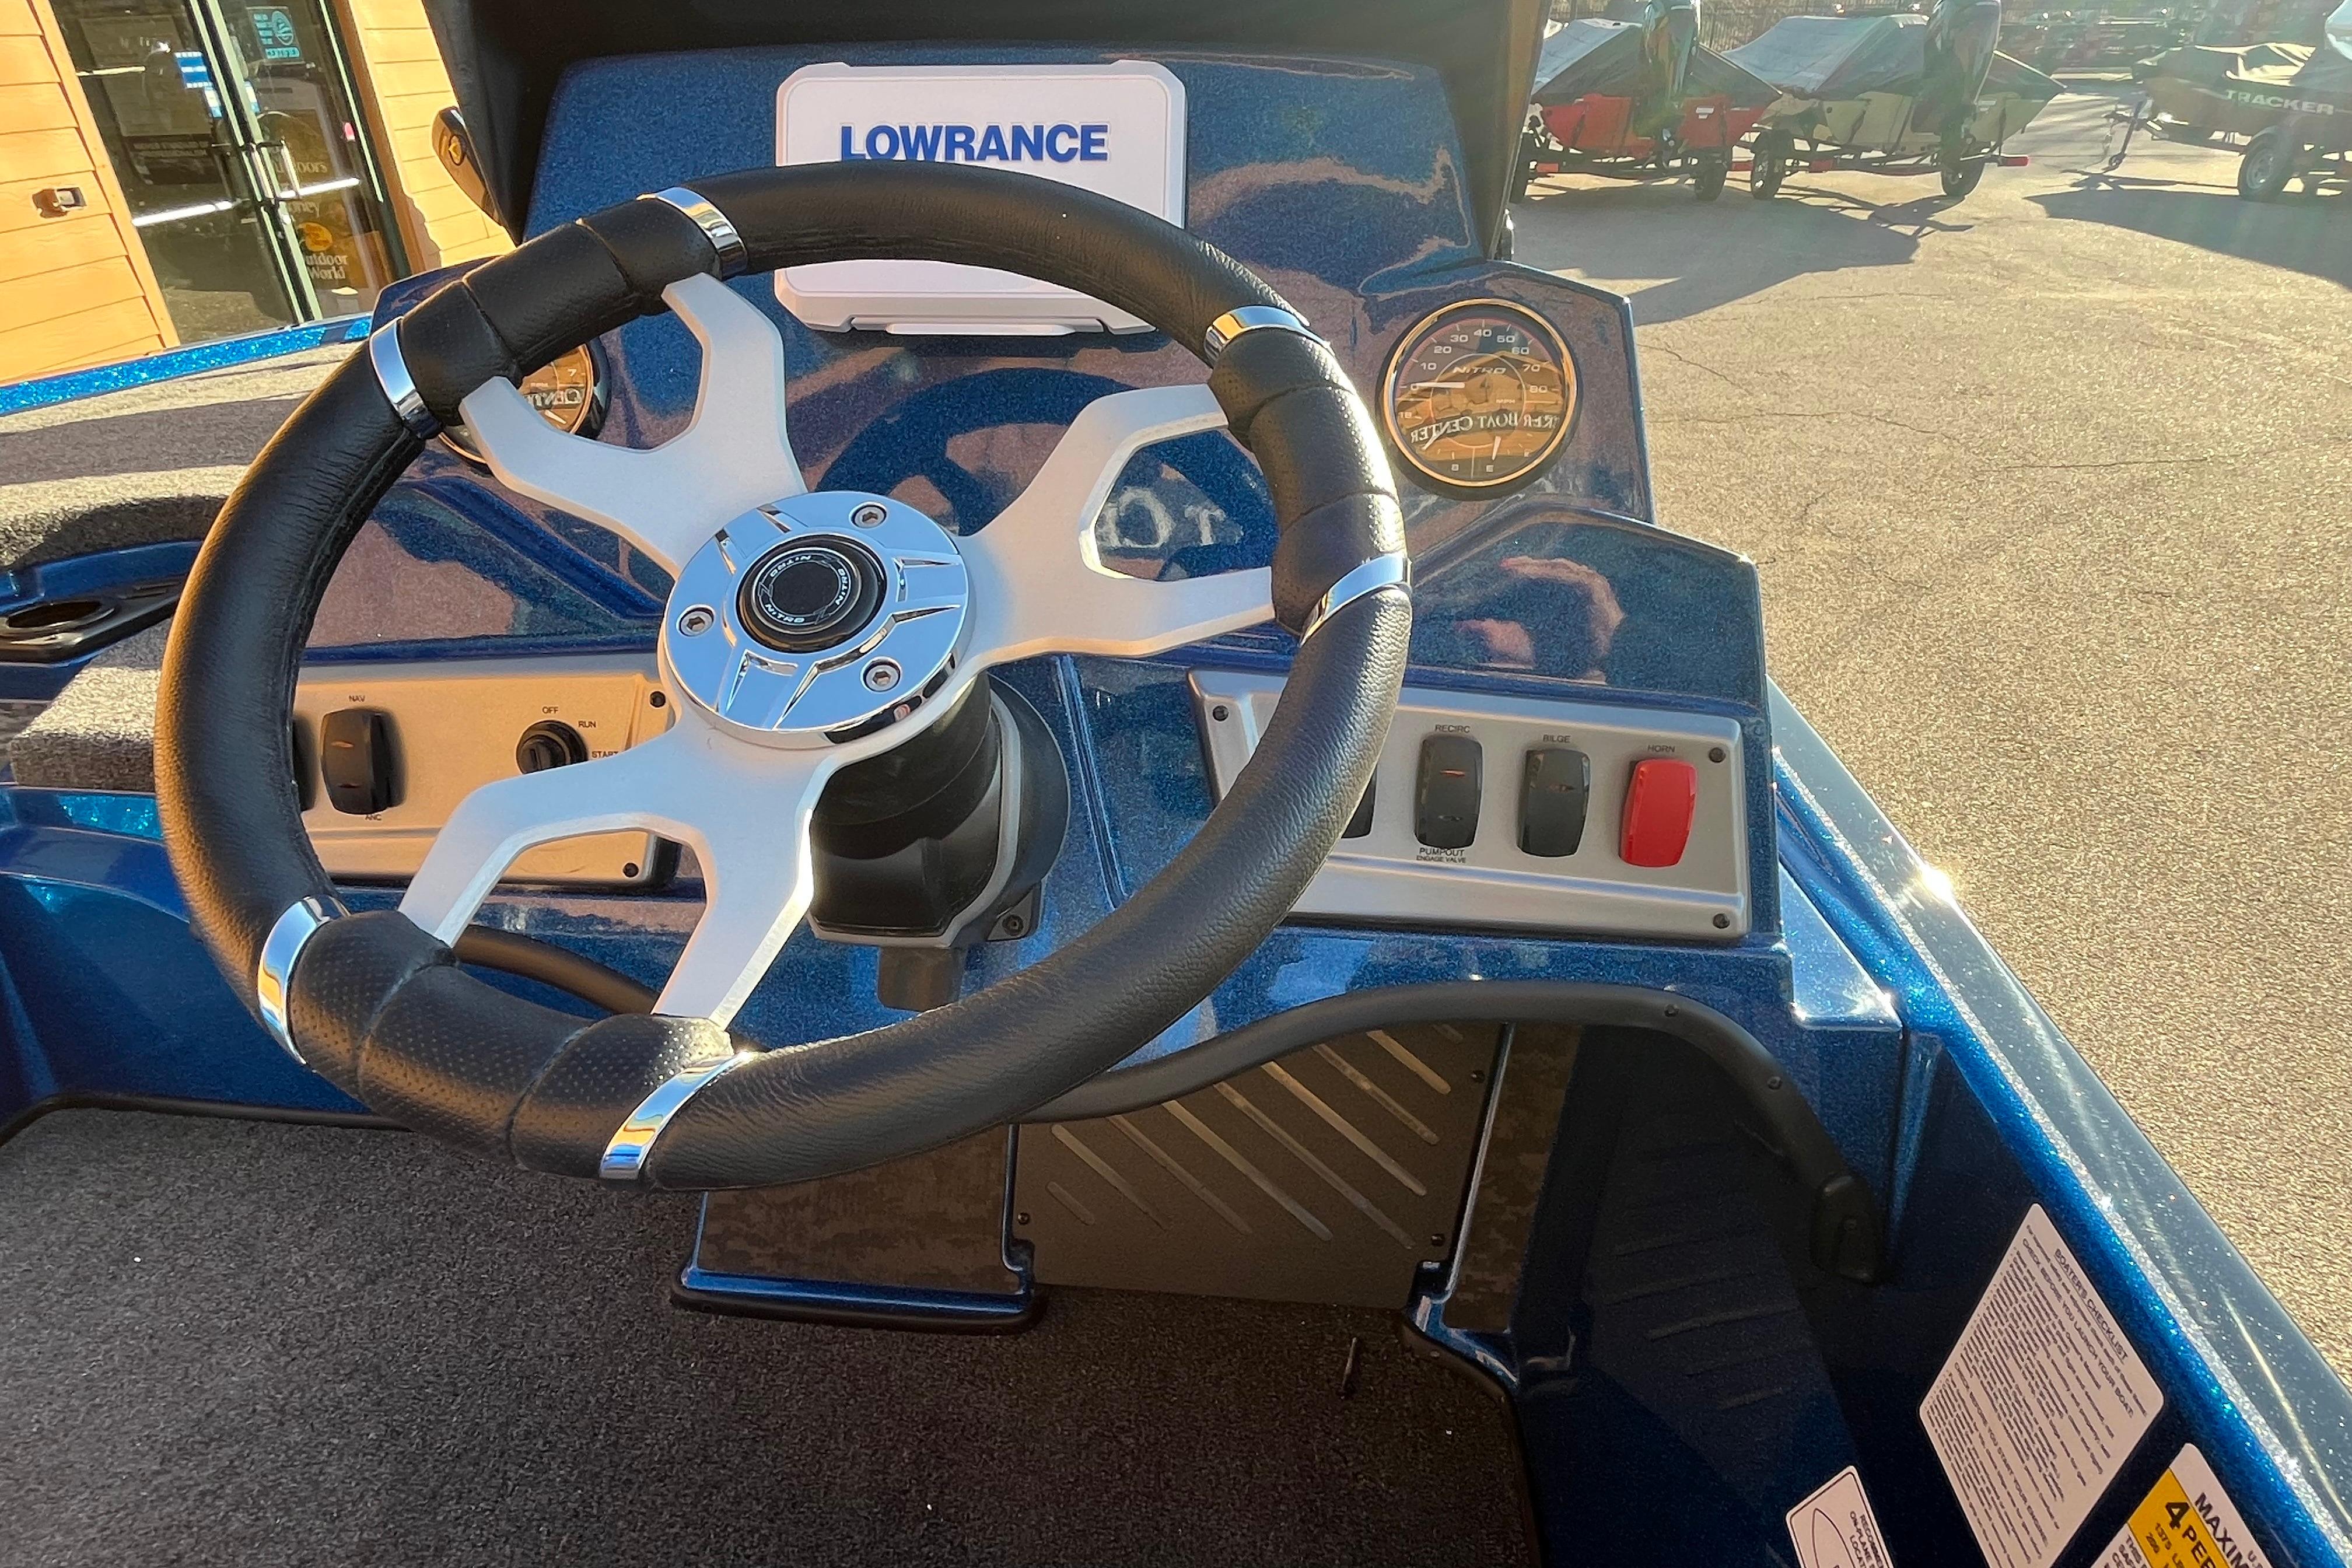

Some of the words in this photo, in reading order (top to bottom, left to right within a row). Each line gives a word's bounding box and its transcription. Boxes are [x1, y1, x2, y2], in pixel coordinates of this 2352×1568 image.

[2225, 89, 2334, 116] TRACKER
[841, 124, 1108, 162] LOWRANCE
[305, 252, 348, 266] utdoor
[1474, 328, 1492, 337] 40
[1450, 334, 1469, 343] 30
[1497, 335, 1516, 343] 50
[1434, 345, 1452, 354] 20
[1511, 346, 1530, 355] 60
[1420, 362, 1437, 370] 10
[1522, 364, 1540, 372] 70
[1530, 385, 1548, 393] 80
[769, 555, 812, 578] NITRO
[835, 568, 849, 606] NITRO
[765, 603, 806, 623] NITRO
[541, 706, 559, 714] OFF
[578, 720, 596, 729] RUN
[1434, 724, 1471, 733] RECIRC
[1542, 734, 1571, 743] BILGE
[1647, 744, 1676, 753] HORN
[1419, 846, 1465, 856] PUMPOUT
[2054, 1247, 2088, 1300] BOATER'S
[2086, 1296, 2128, 1363] CHECKLIST
[2022, 1236, 2041, 1268] CHECK
[2061, 1300, 2075, 1323] YOU
[2096, 1358, 2116, 1390] YOUR
[1987, 1426, 1999, 1448] YOU
[2012, 1475, 2028, 1505] YOUR
[2165, 1502, 2190, 1530] 4
